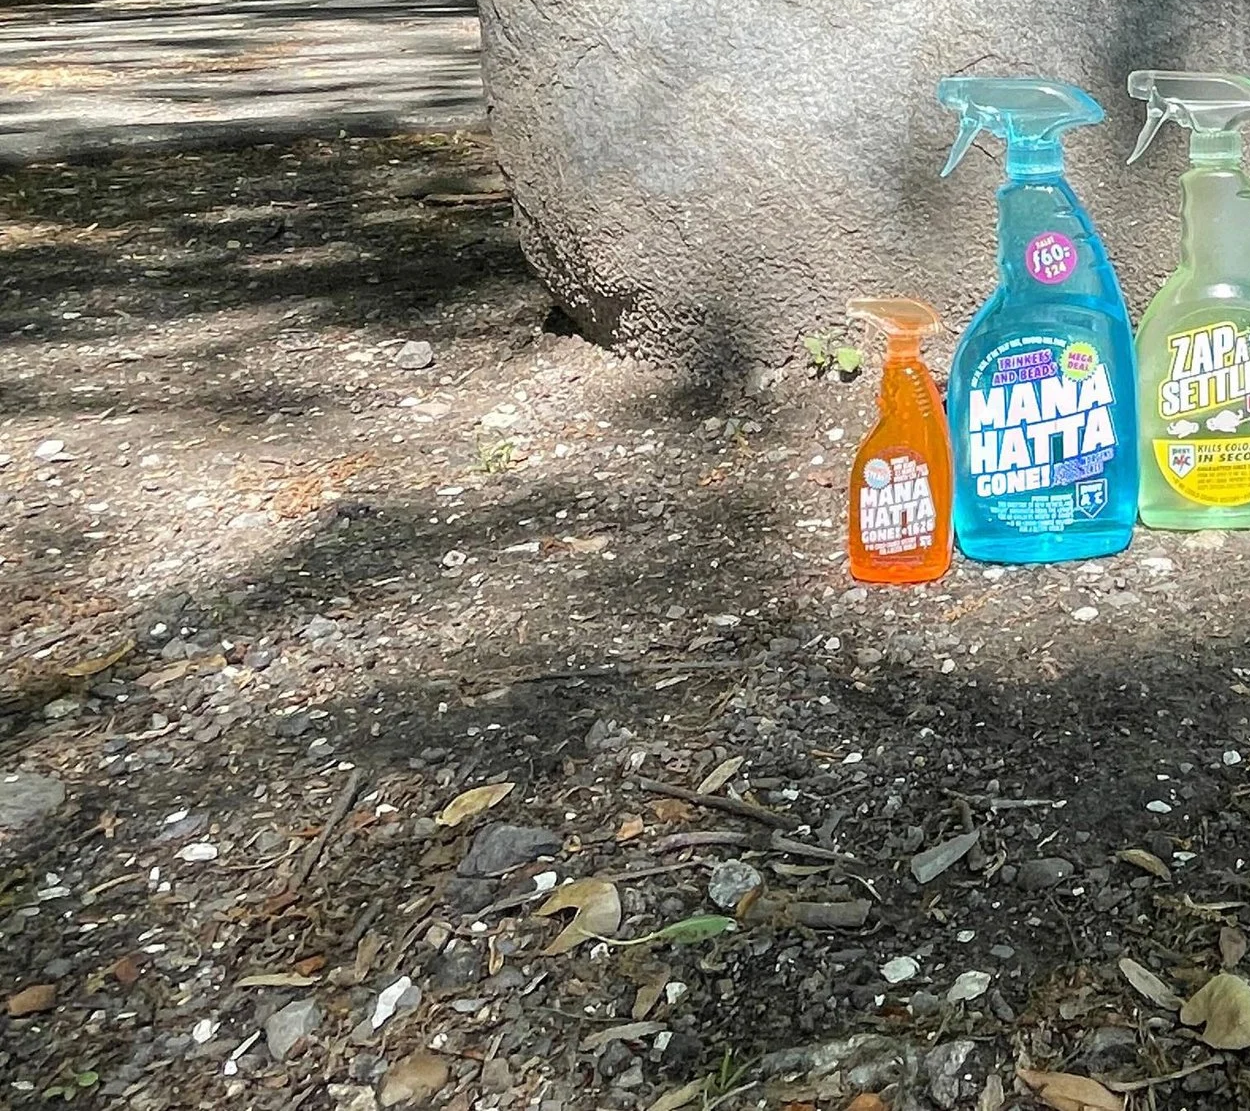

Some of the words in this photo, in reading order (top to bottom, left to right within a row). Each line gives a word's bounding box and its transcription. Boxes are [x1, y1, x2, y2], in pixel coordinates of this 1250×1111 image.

[999, 350, 1052, 370] TRINKETS
[1068, 352, 1093, 363] MEGA
[1172, 326, 1234, 381] ZAP
[1235, 336, 1250, 365] A
[994, 371, 1016, 385] AND
[1020, 363, 1056, 381] BEADS
[1067, 361, 1090, 372] DEAL
[970, 364, 1114, 431] MANA
[970, 407, 1116, 474] HATTA
[1197, 442, 1222, 453] KILLS
[1198, 454, 1214, 464] IN
[861, 477, 929, 508] MANA
[861, 498, 935, 531] HATTA
